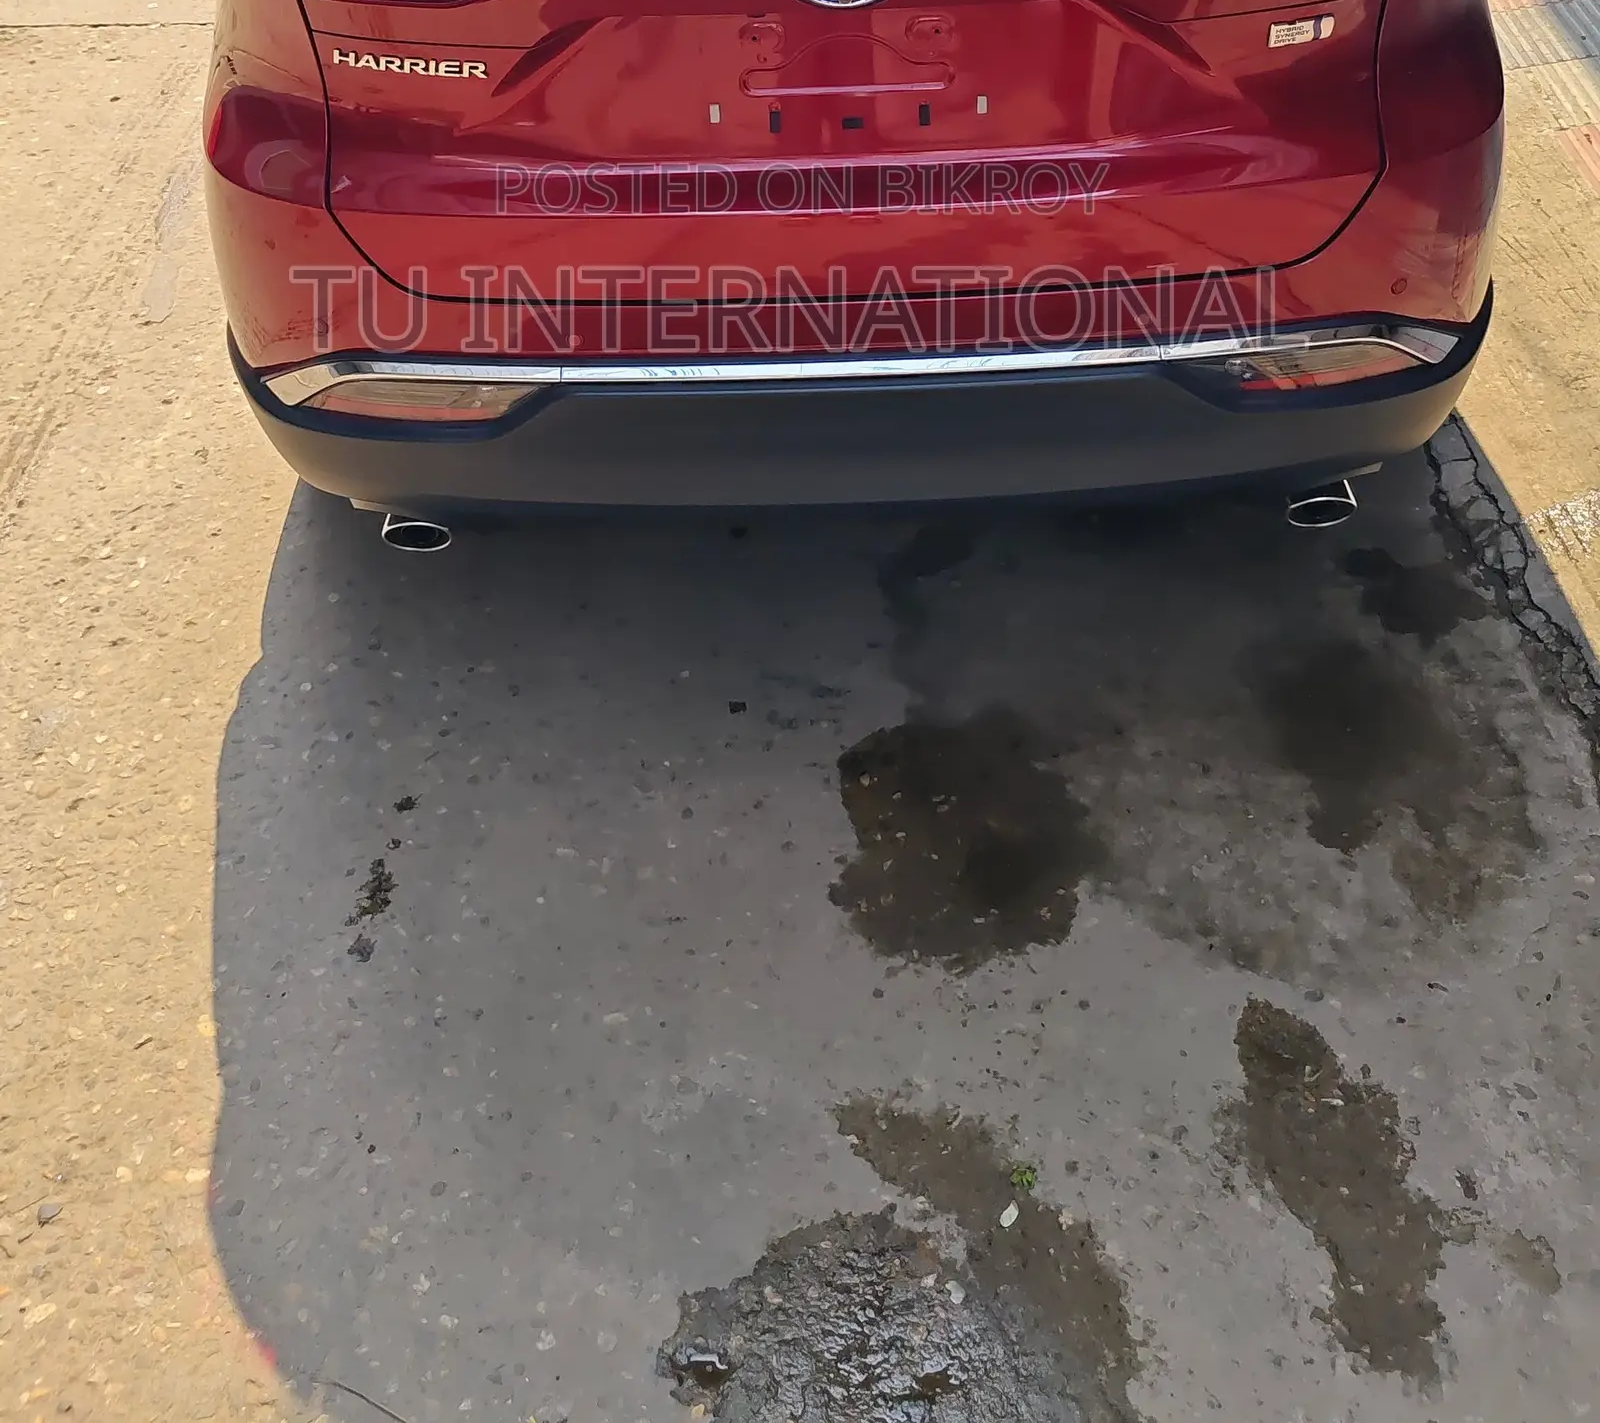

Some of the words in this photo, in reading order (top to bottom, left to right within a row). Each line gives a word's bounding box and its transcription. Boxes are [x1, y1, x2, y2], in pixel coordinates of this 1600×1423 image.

[1274, 29, 1310, 40] SYNERGY
[1275, 25, 1304, 34] HYBRID
[1273, 37, 1297, 45] DRIVE
[332, 49, 488, 79] HARRIER
